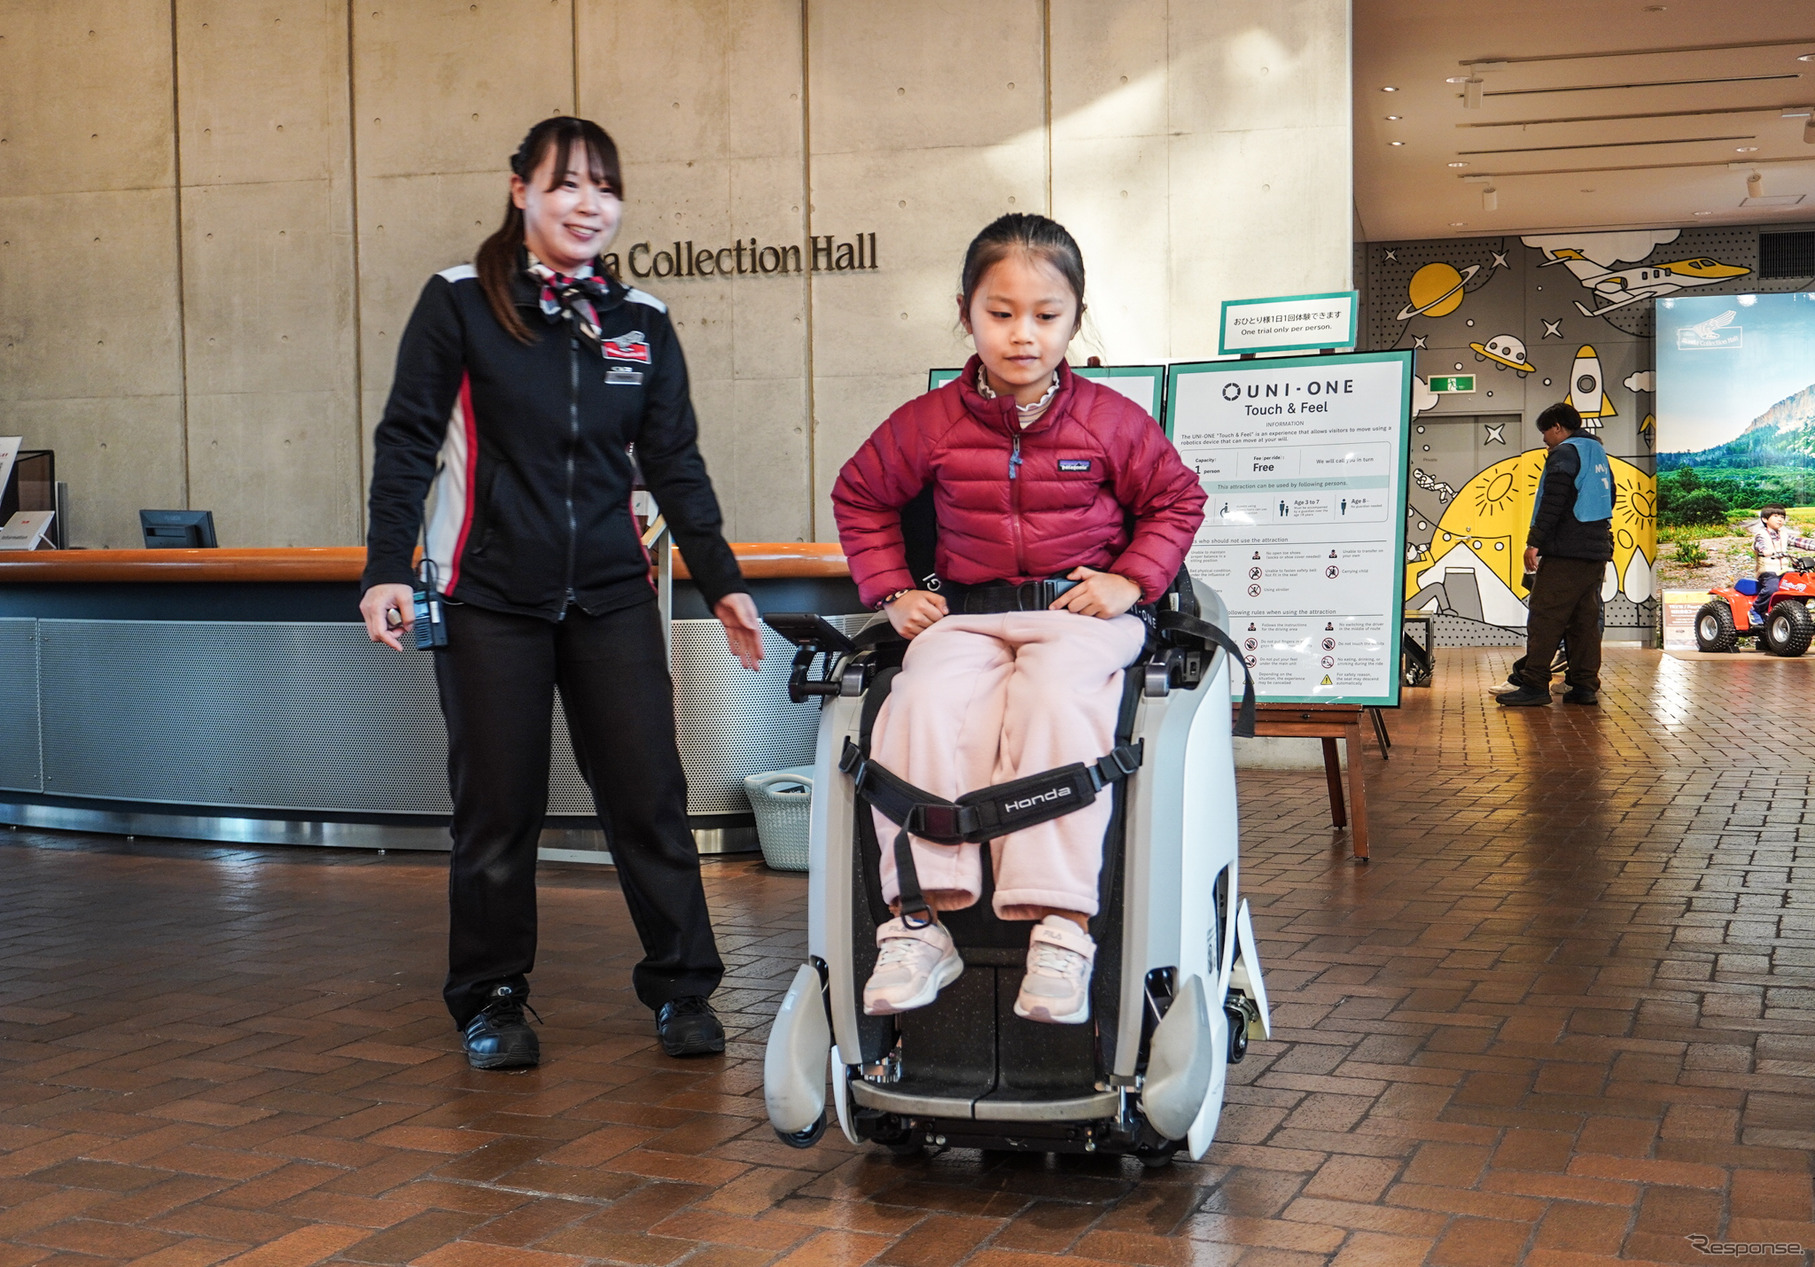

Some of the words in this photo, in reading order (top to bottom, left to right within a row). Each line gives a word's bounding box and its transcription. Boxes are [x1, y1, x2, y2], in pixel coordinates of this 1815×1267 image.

[628, 238, 803, 278] Collection
[809, 232, 878, 271] Hall
[1234, 310, 1342, 326] おひとり様1日1回体験できます
[1257, 327, 1272, 335] trial
[1274, 326, 1289, 336] only
[1291, 326, 1303, 335] per
[1305, 324, 1332, 334] person.
[1245, 404, 1282, 416] Touch
[1288, 404, 1296, 414] &
[1300, 401, 1328, 412] Feel
[1195, 465, 1201, 474] 1
[1253, 463, 1274, 472] Free
[1004, 786, 1072, 813] Honda
